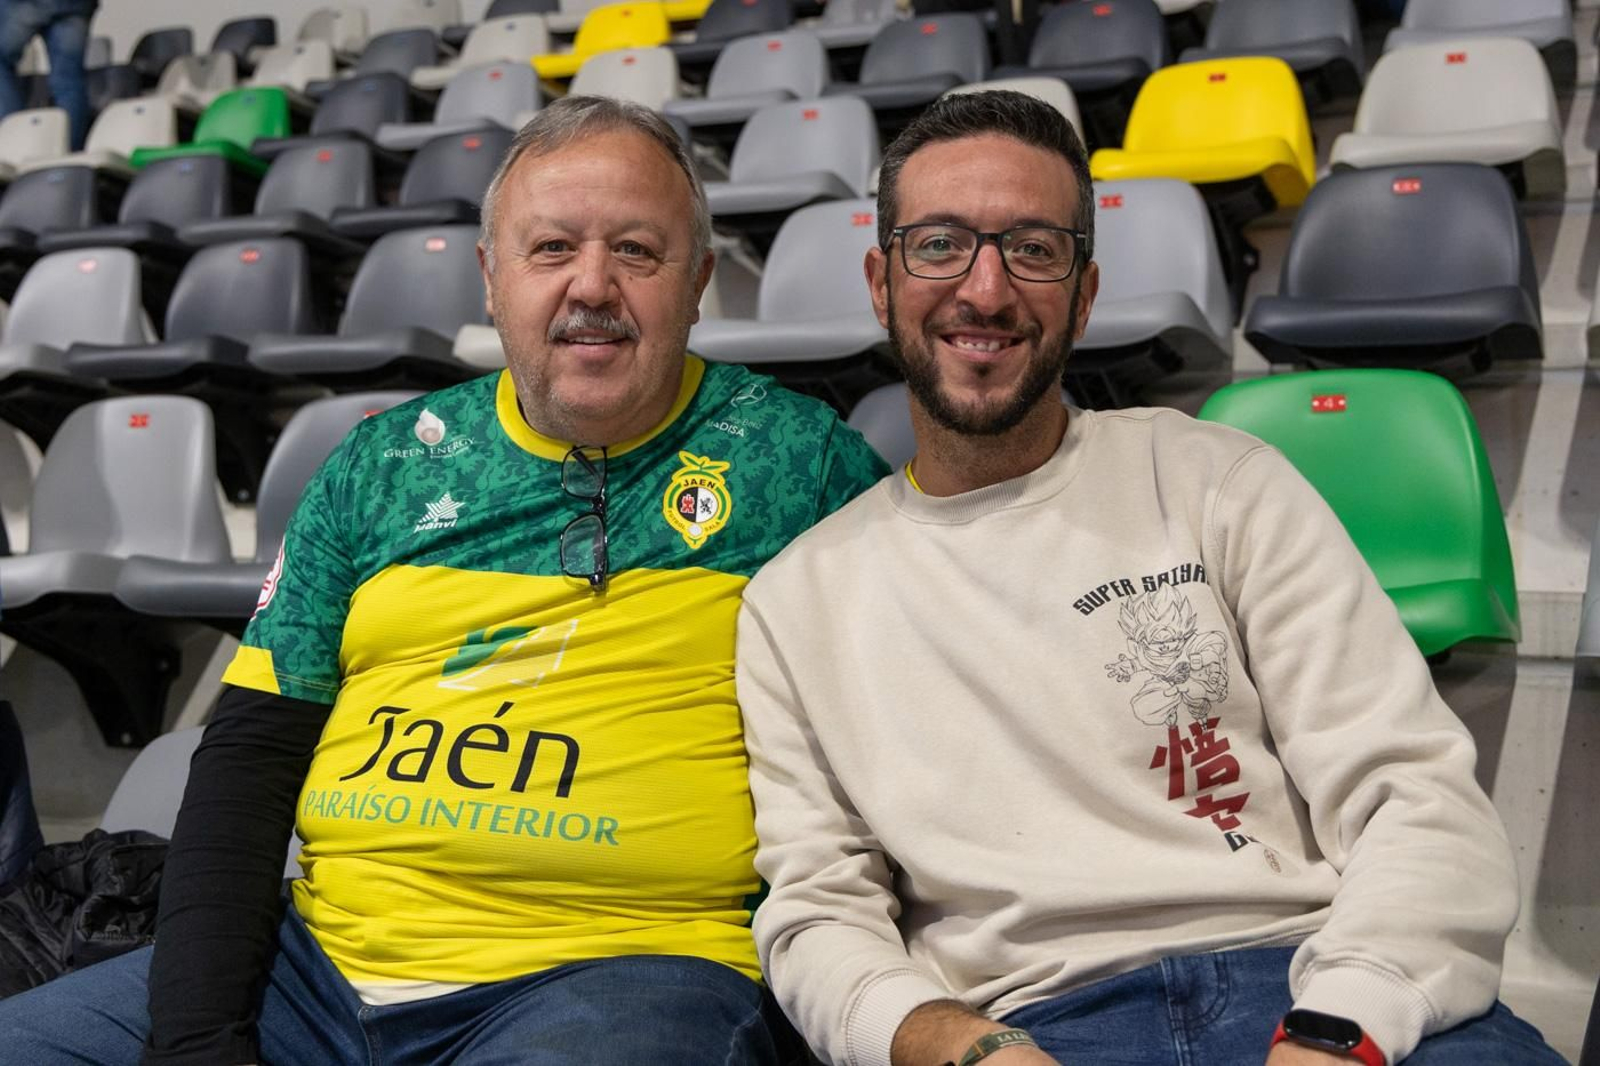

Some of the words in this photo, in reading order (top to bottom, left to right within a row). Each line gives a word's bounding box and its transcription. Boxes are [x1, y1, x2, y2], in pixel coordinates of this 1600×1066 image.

[383, 447, 426, 458] GREEN
[429, 437, 475, 455] ENERGY
[683, 478, 716, 489] JAEN
[1072, 578, 1138, 616] SUPER
[1141, 563, 1209, 593] SAIYA
[338, 701, 580, 798] Jaén
[303, 785, 411, 824] PARAÍSO
[419, 797, 620, 846] INTERIOR
